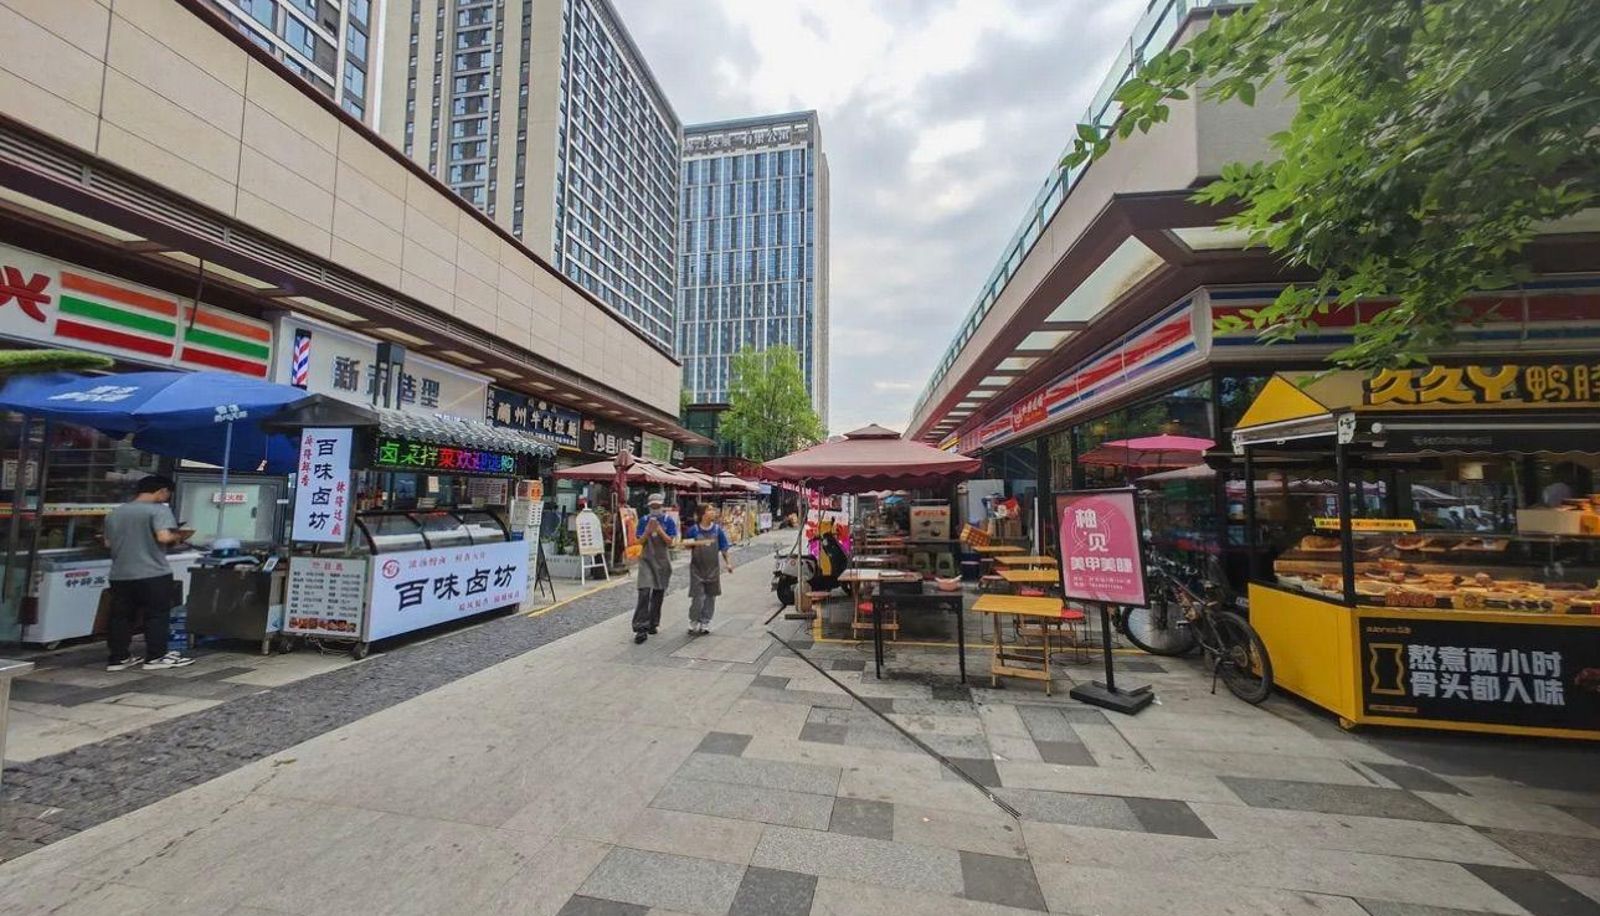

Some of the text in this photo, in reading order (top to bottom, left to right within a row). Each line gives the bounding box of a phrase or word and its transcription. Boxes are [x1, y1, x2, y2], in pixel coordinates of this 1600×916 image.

[379, 440, 515, 473] 卤菜拌菜欢迎选购
[308, 437, 338, 531] 百味卤坊
[395, 563, 517, 612] 百味卤坊
[1408, 643, 1564, 679] 熬煮两小时
[1410, 671, 1567, 707] 骨头都入味
